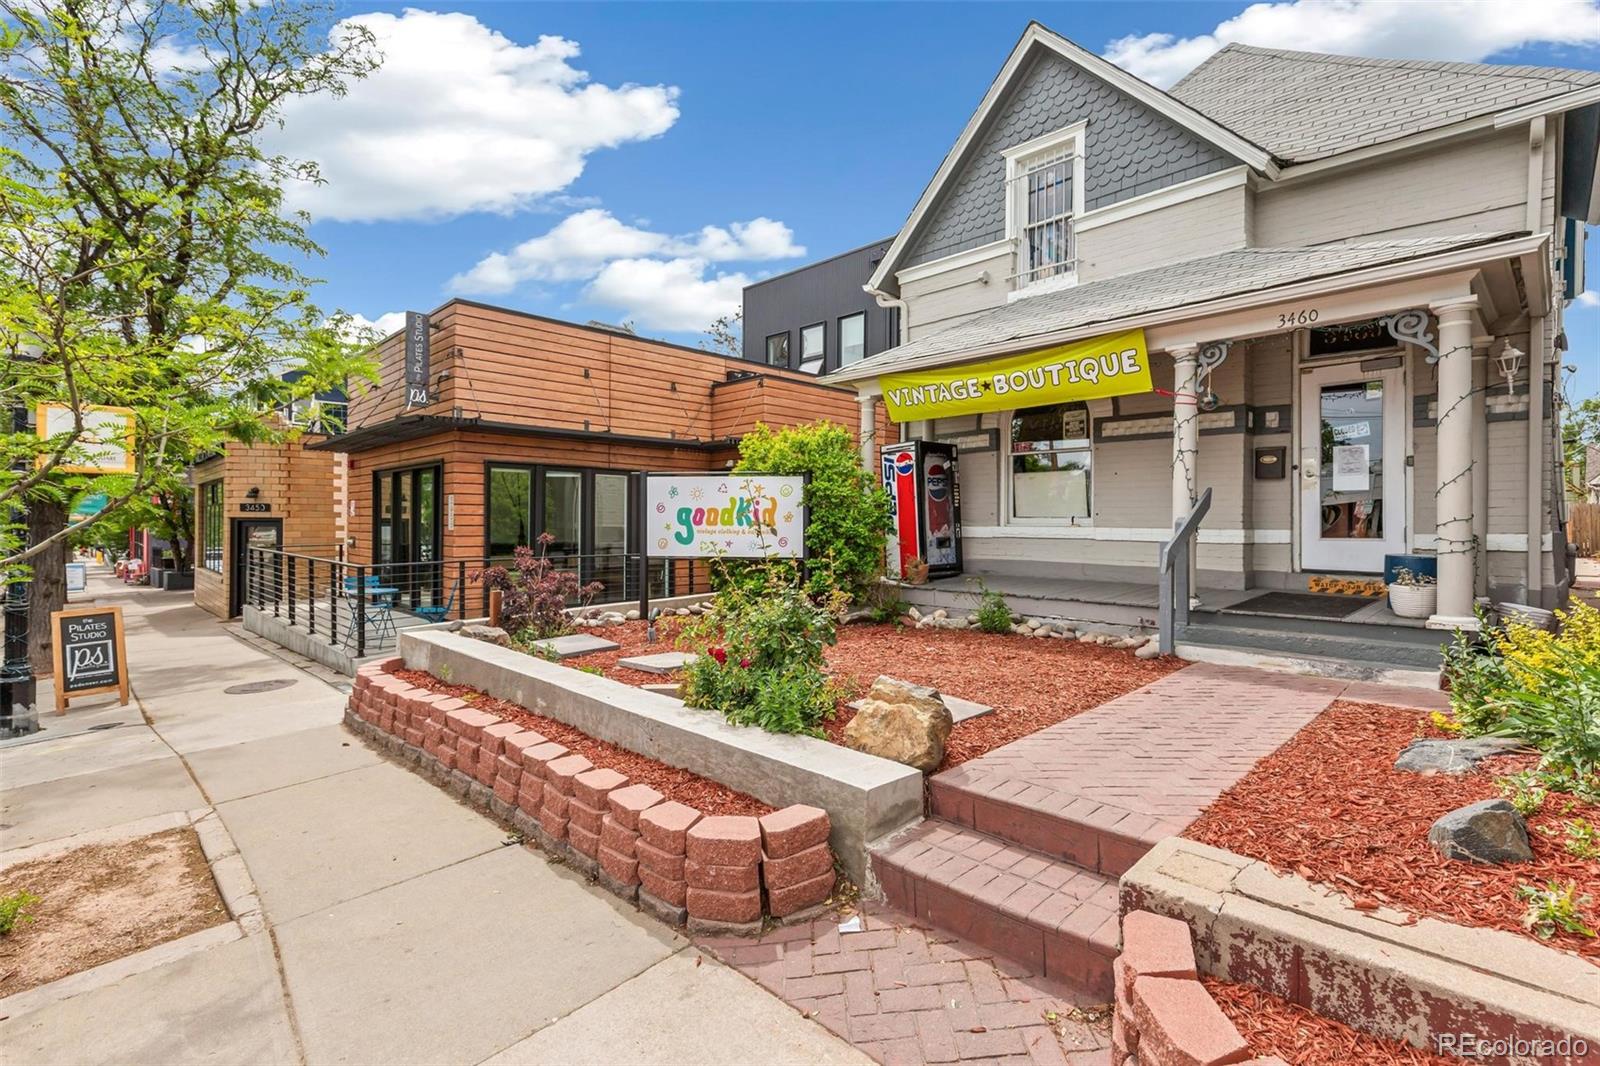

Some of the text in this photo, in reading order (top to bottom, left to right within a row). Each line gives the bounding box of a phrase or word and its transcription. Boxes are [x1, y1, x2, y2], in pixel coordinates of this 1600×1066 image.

[1278, 309, 1319, 329] 3460
[888, 349, 1141, 407] VINTAGE BOUTIQUE
[69, 622, 107, 633] PILATES
[71, 631, 106, 641] STUDIO
